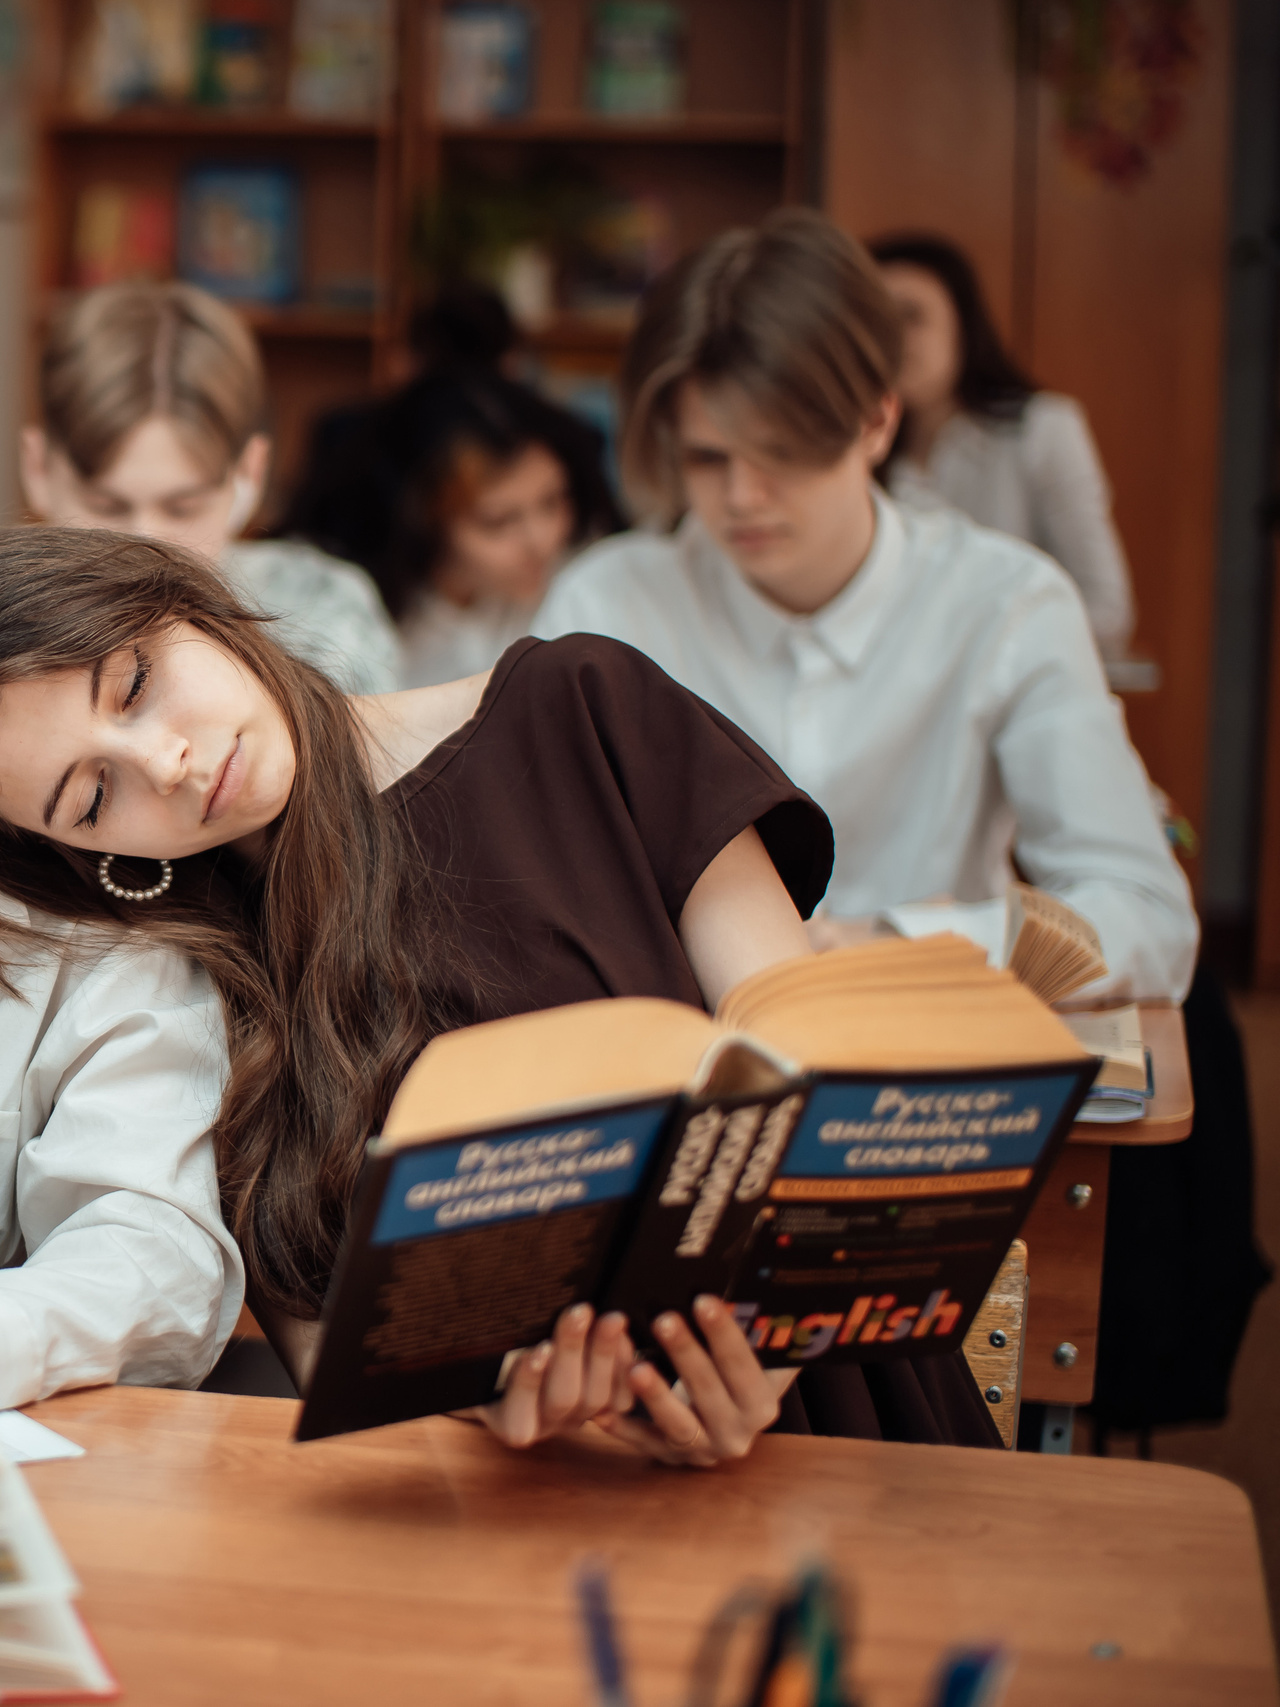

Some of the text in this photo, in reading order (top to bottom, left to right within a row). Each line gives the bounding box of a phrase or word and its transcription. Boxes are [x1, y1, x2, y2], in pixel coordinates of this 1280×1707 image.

[872, 1087, 1011, 1122] Русско-
[818, 1106, 1041, 1144] английский
[405, 1137, 635, 1210] английский
[844, 1142, 990, 1172] словарь
[434, 1178, 588, 1228] словарь
